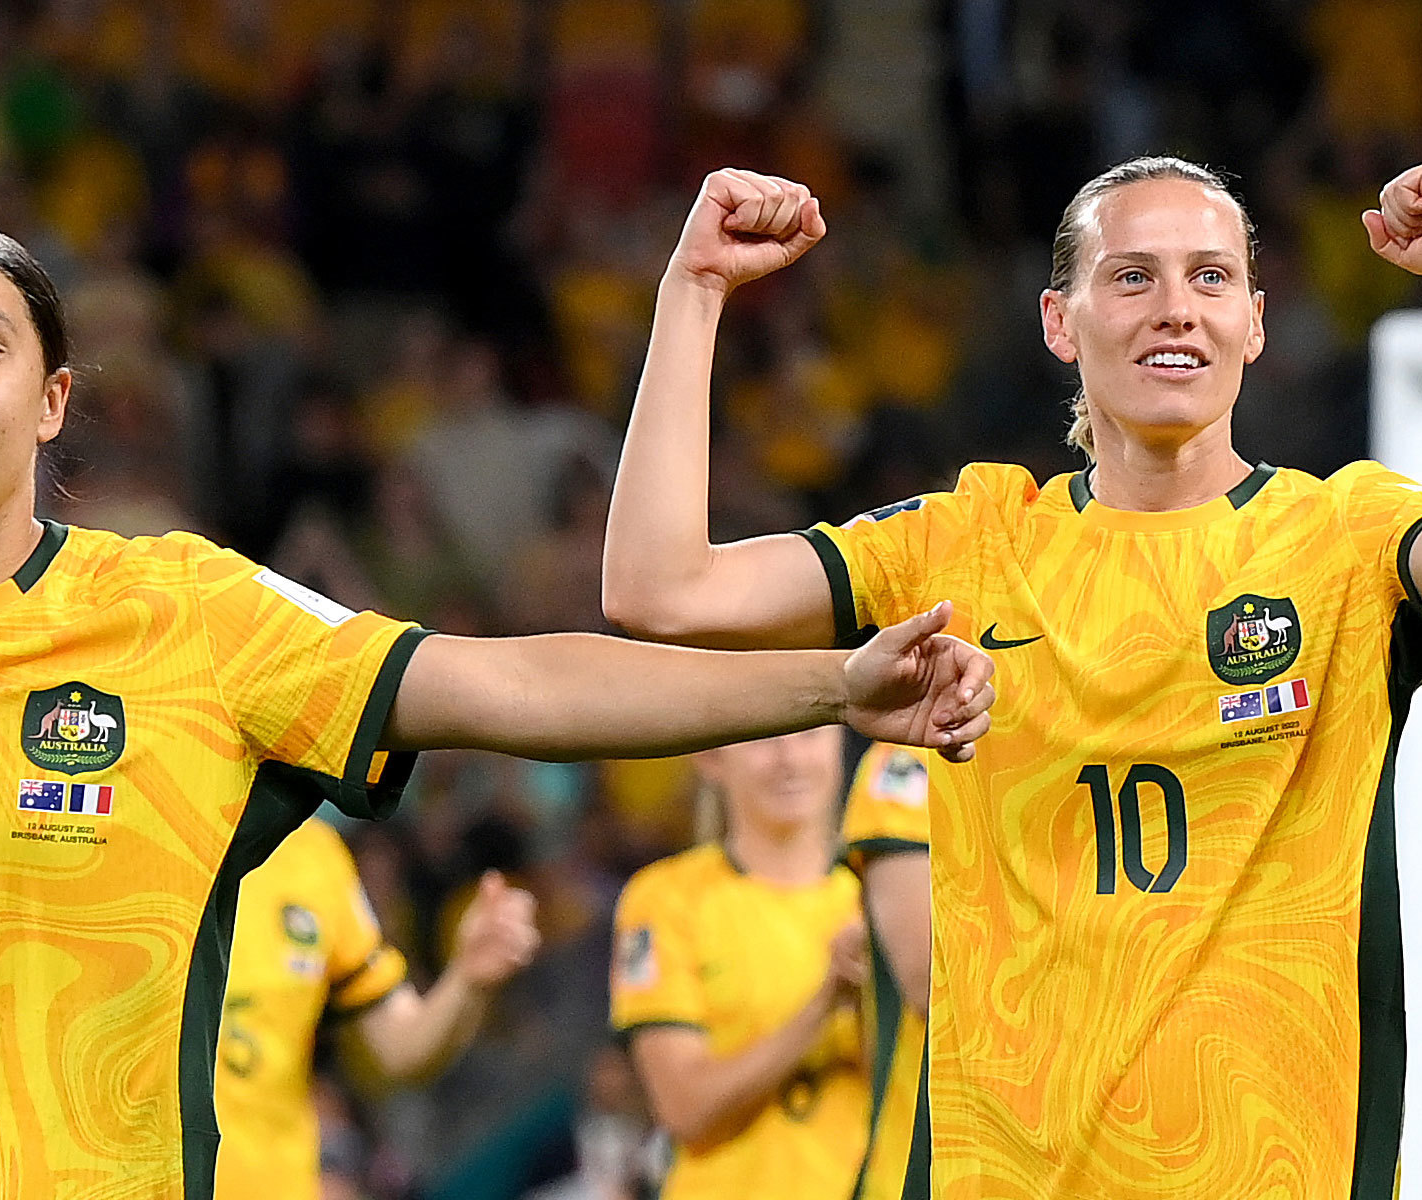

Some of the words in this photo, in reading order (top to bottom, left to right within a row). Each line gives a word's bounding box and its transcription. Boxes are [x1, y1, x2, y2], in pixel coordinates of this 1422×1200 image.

[1226, 644, 1288, 666] AUSTRALIA
[1244, 724, 1279, 736] AUGUST
[39, 738, 107, 752] AUSTRALIA
[1220, 737, 1266, 749] BRISBANE,
[1268, 728, 1313, 741] AUSTRALI
[38, 823, 74, 833] AUGUST
[1076, 763, 1188, 895] 10
[11, 831, 58, 843] BRISBANE,
[60, 835, 108, 845] AUSTRALIA
